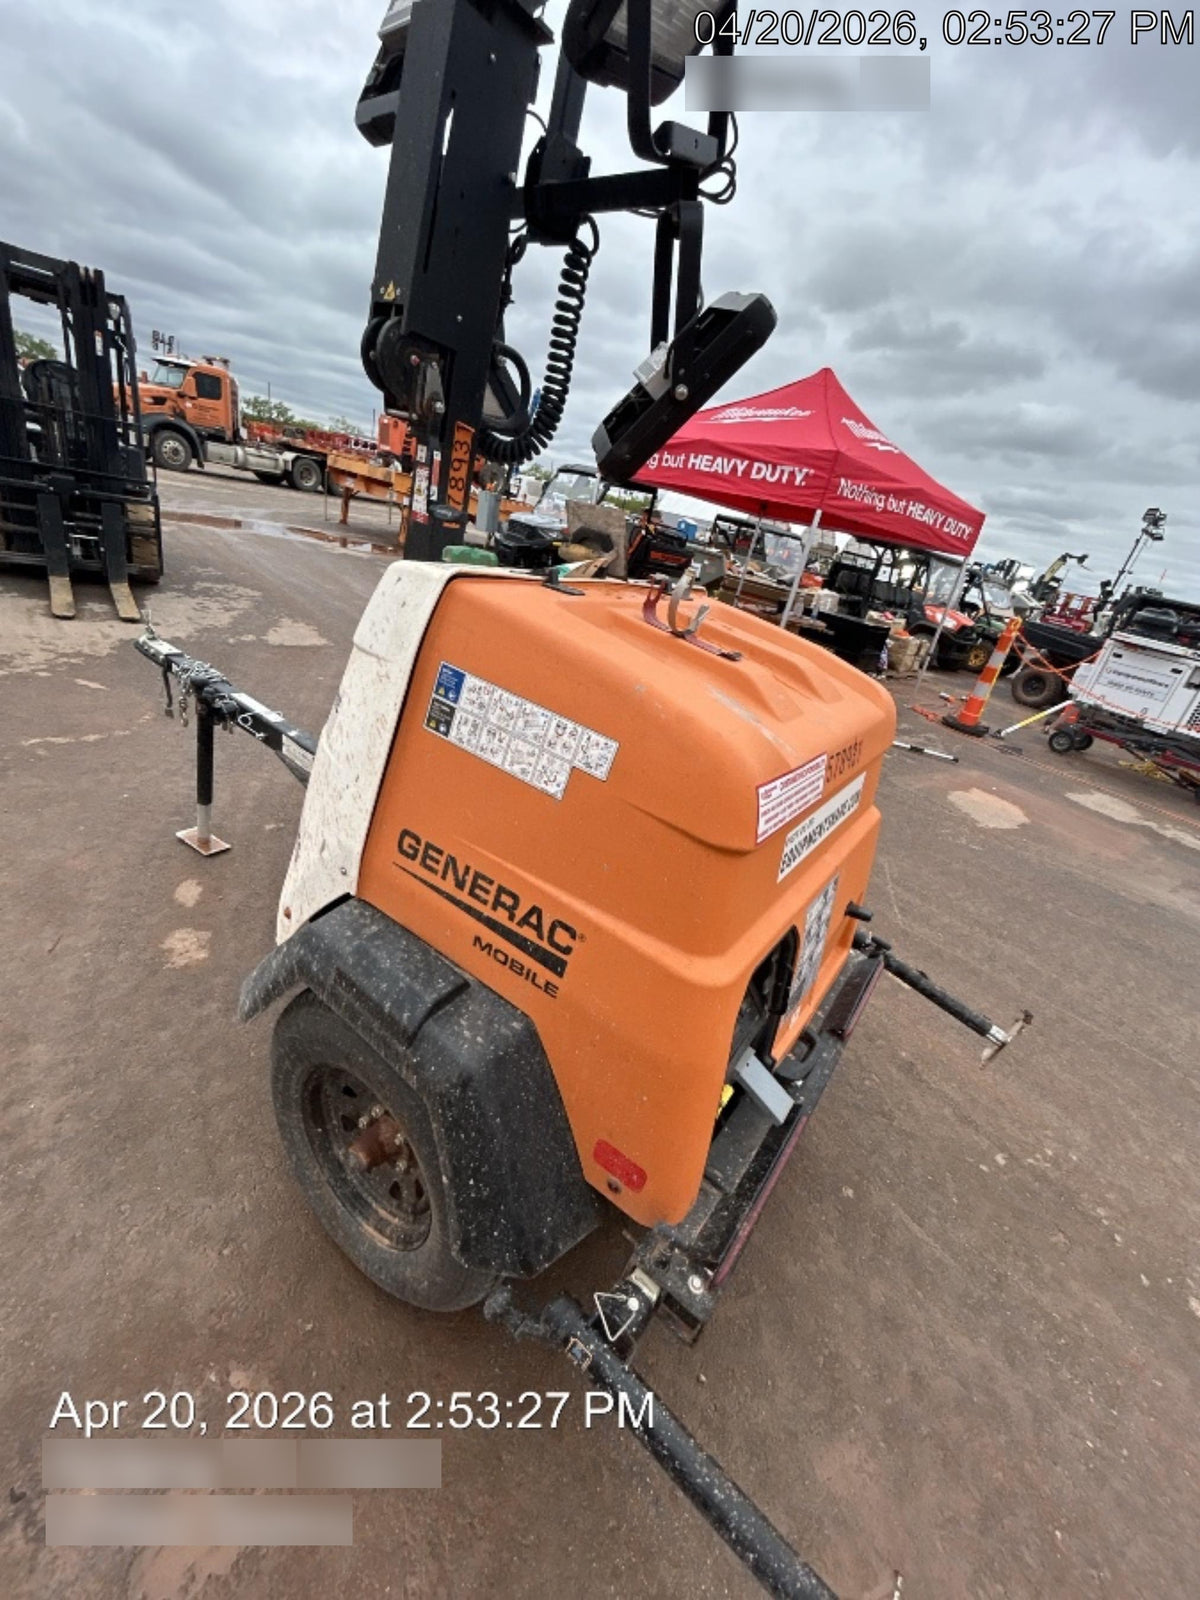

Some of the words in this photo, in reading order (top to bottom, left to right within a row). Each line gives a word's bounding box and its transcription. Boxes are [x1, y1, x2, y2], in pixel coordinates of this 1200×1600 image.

[661, 451, 686, 469] but
[688, 453, 749, 477] HEAVY
[837, 477, 886, 512] Nothing
[886, 493, 907, 515] but
[906, 500, 946, 529] HEAVY
[397, 828, 577, 956] GENERAC
[472, 935, 560, 999] MOBILE
